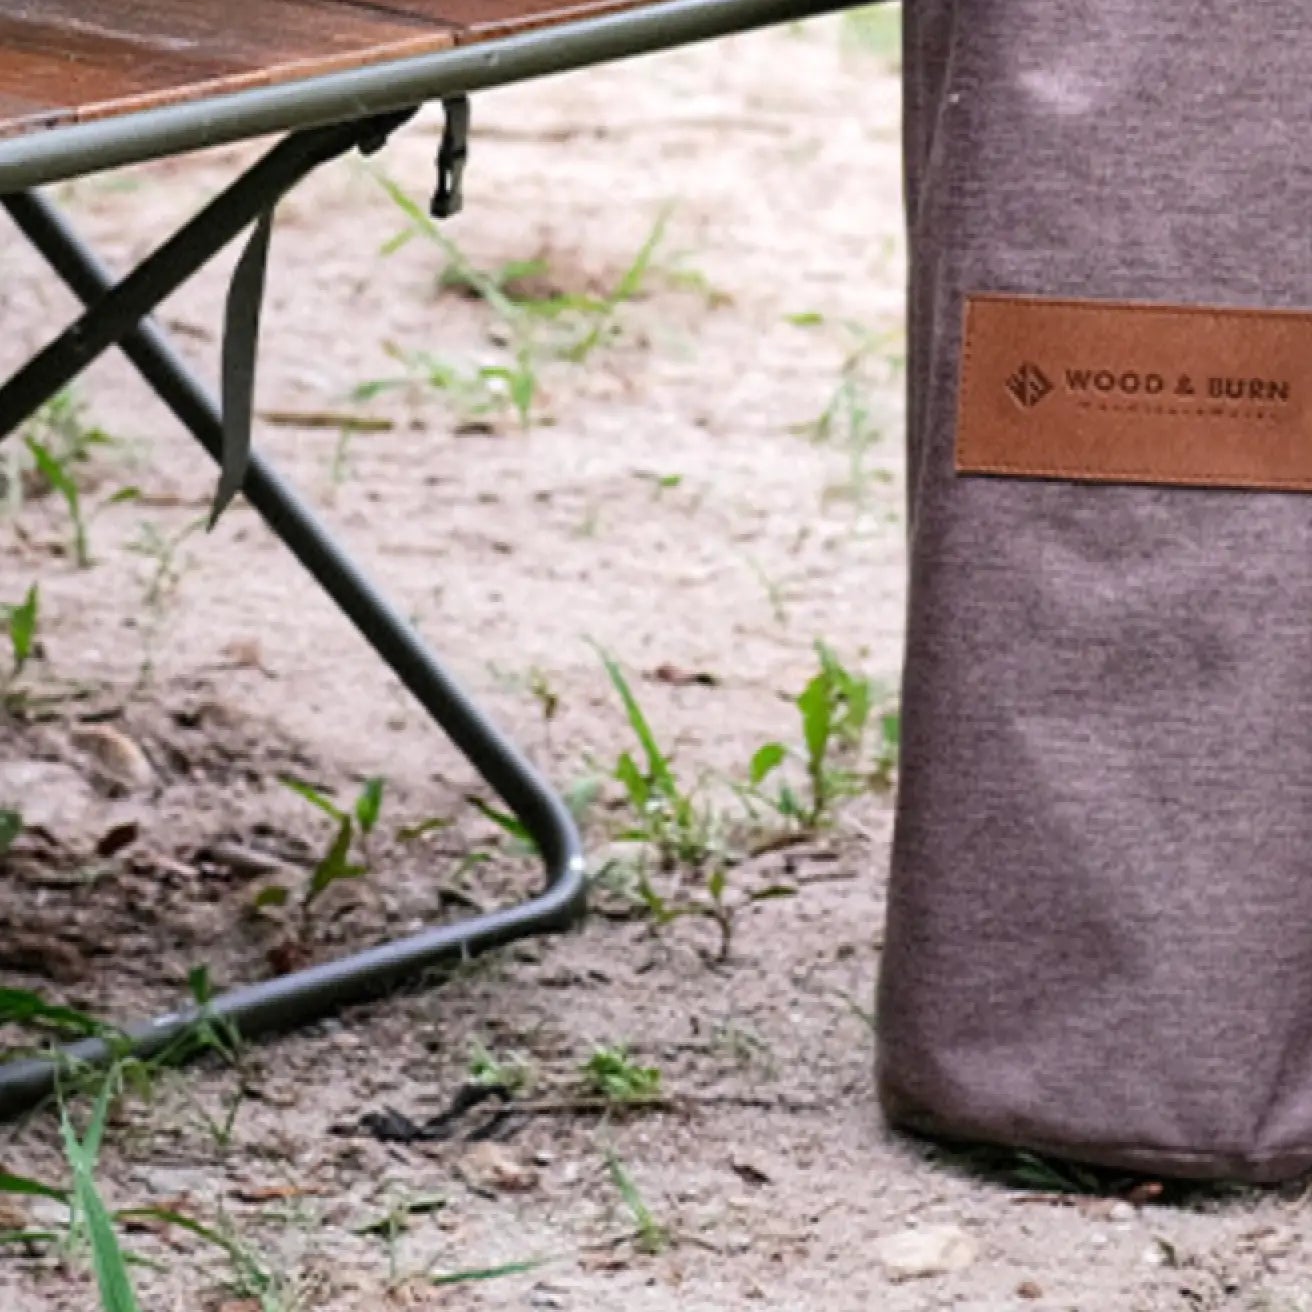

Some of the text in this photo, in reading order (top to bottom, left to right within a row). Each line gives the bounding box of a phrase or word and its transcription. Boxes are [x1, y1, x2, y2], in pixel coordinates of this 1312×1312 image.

[1065, 368, 1290, 403] WOOD & BURN
